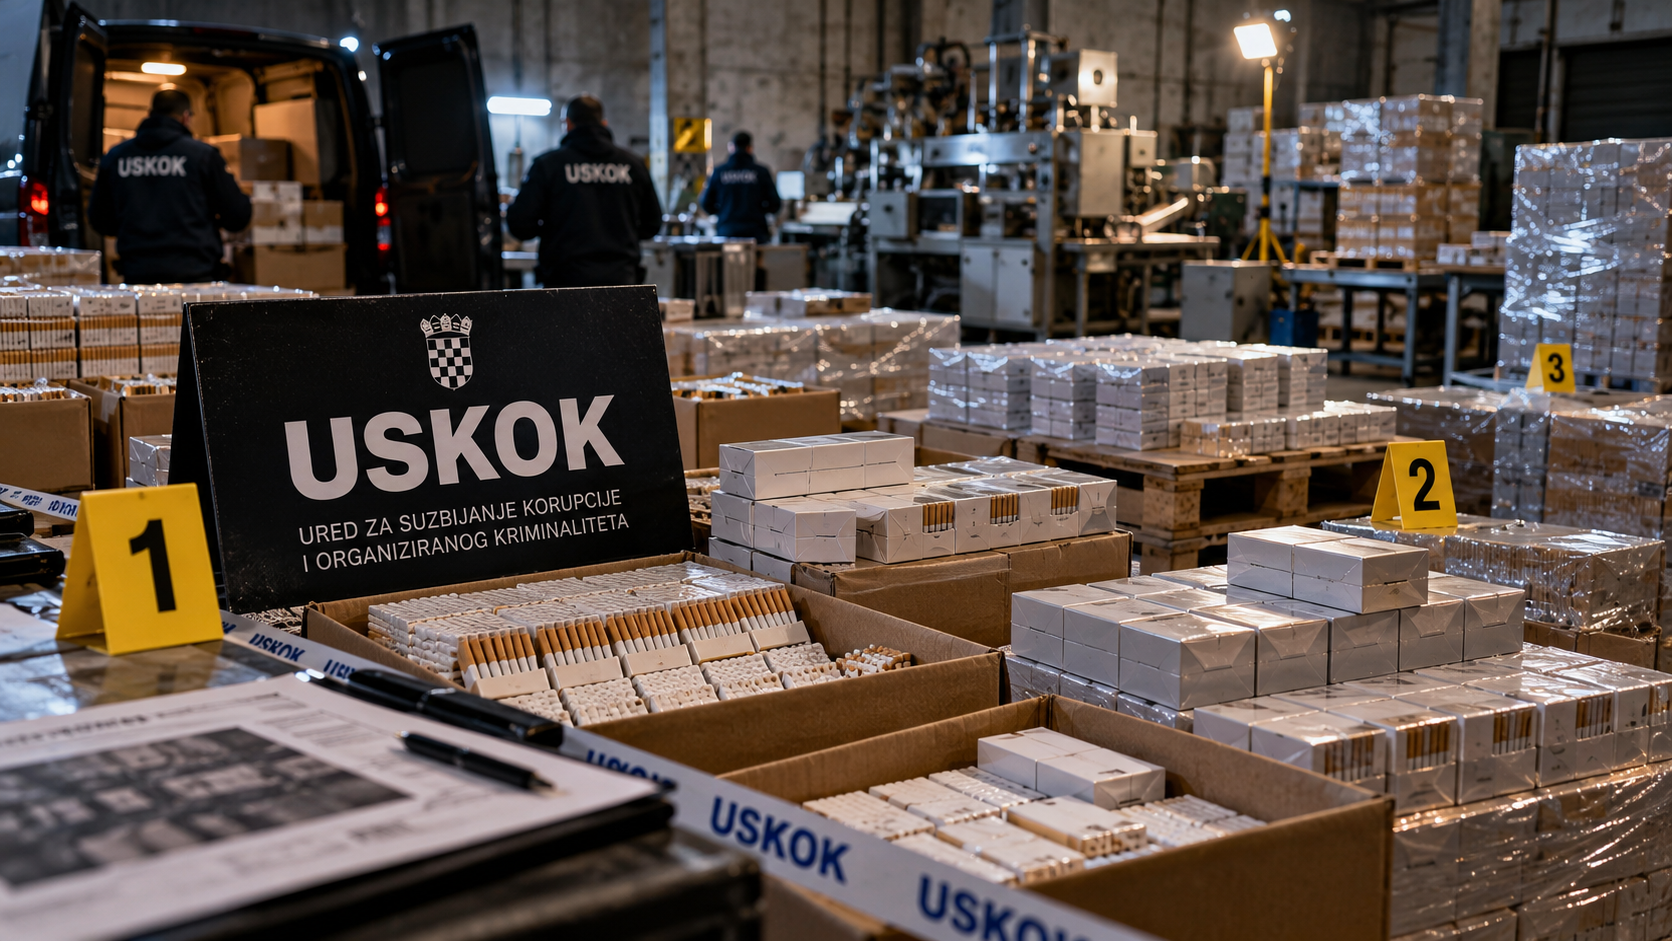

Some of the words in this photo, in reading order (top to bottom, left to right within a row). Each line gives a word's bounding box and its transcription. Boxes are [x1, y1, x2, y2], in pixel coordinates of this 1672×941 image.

[118, 155, 187, 178] USKOK
[564, 162, 632, 184] USKOK
[1548, 352, 1565, 384] 3
[284, 394, 625, 500] USKOK
[1409, 458, 1440, 511] 2
[299, 520, 358, 545] URED
[365, 517, 393, 537] ZA
[399, 501, 518, 532] SUZBIJANJE
[523, 489, 622, 517] KORUPCIJE
[302, 555, 309, 572] I
[316, 531, 488, 570] ORGANIZIRANOG
[494, 513, 629, 546] KRIMINALITETA
[129, 518, 177, 613] 1
[710, 795, 851, 885] USKOK
[917, 873, 1094, 941] USKO
